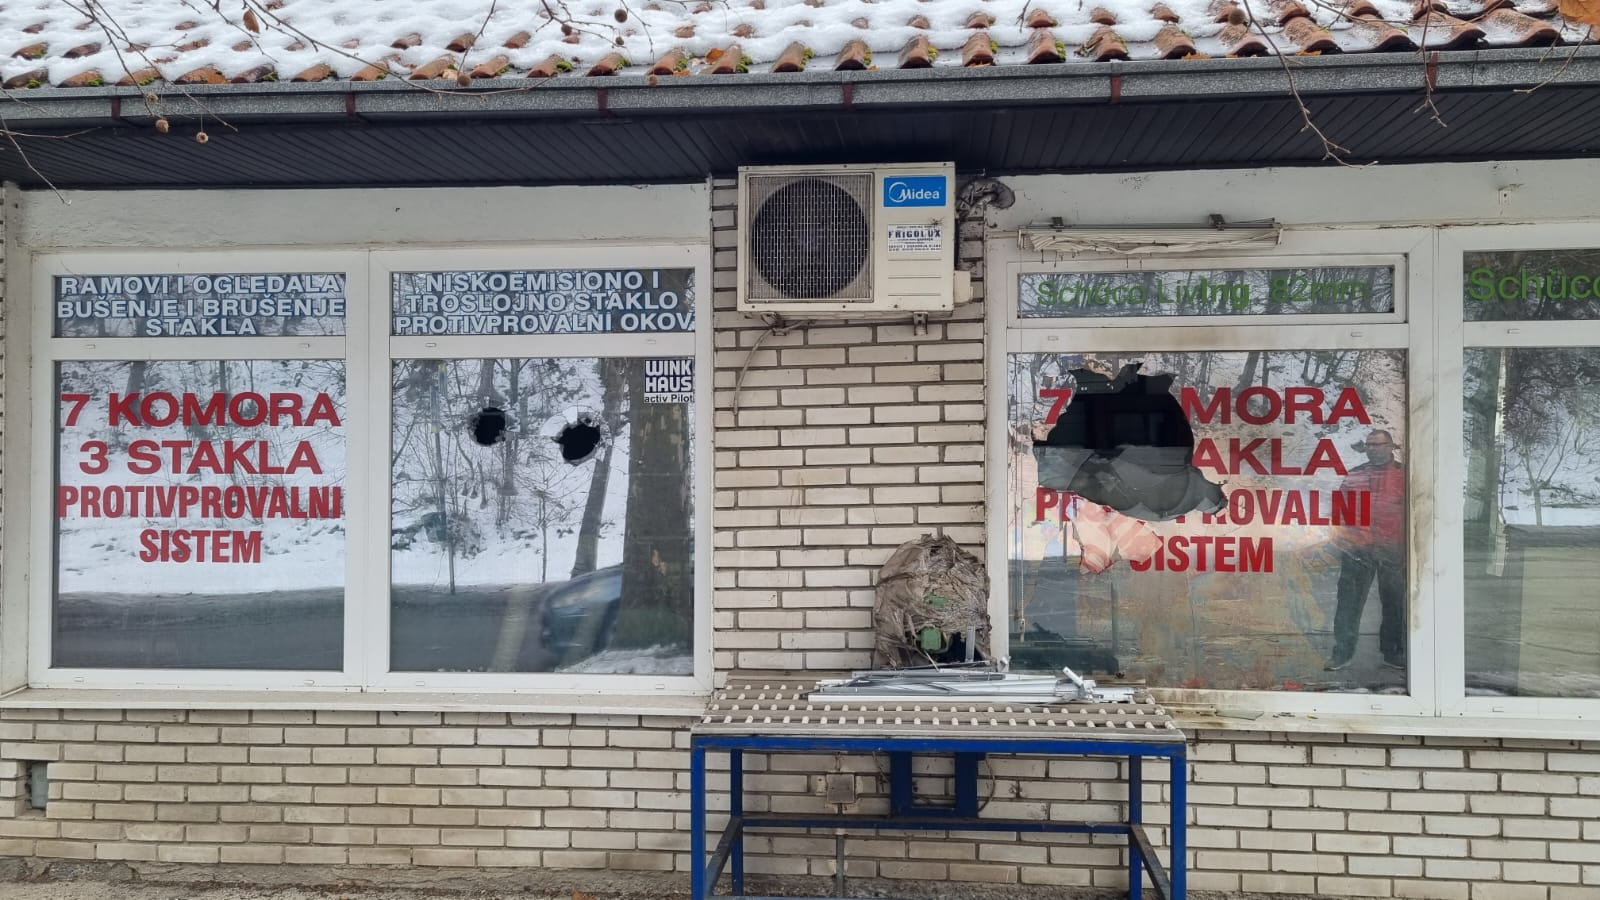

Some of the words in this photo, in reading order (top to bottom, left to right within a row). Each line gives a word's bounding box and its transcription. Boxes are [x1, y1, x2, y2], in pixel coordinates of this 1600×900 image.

[889, 182, 940, 203] Midea
[888, 229, 941, 238] FRIGOLUX
[61, 277, 169, 295] RAMOVI
[177, 277, 184, 294] I
[193, 275, 340, 294] OGLEDALA
[425, 271, 643, 292] NISKOEMISIONO
[652, 271, 659, 289] I
[57, 295, 179, 318] BUŠENJE
[187, 299, 194, 316] I
[203, 293, 345, 316] BRUŠENJE
[405, 294, 566, 313] TROSLOJNO
[574, 291, 678, 311] STAKLO
[145, 318, 257, 336] STAKLA
[395, 315, 612, 334] PROTIVPROVALNI
[645, 360, 692, 376] WINK
[645, 376, 692, 392] HAUS
[644, 395, 668, 403] activ
[671, 394, 693, 403] Pilot
[1039, 388, 1072, 425] 7
[1180, 386, 1371, 425] MORA
[61, 392, 90, 426] 7
[108, 391, 342, 428] KOMORA
[79, 440, 109, 475] 3
[127, 440, 323, 475] STAKLA
[1191, 438, 1349, 476] AKLA
[59, 485, 341, 519] PROTIVPROVALNI
[139, 529, 262, 563] SISTEM
